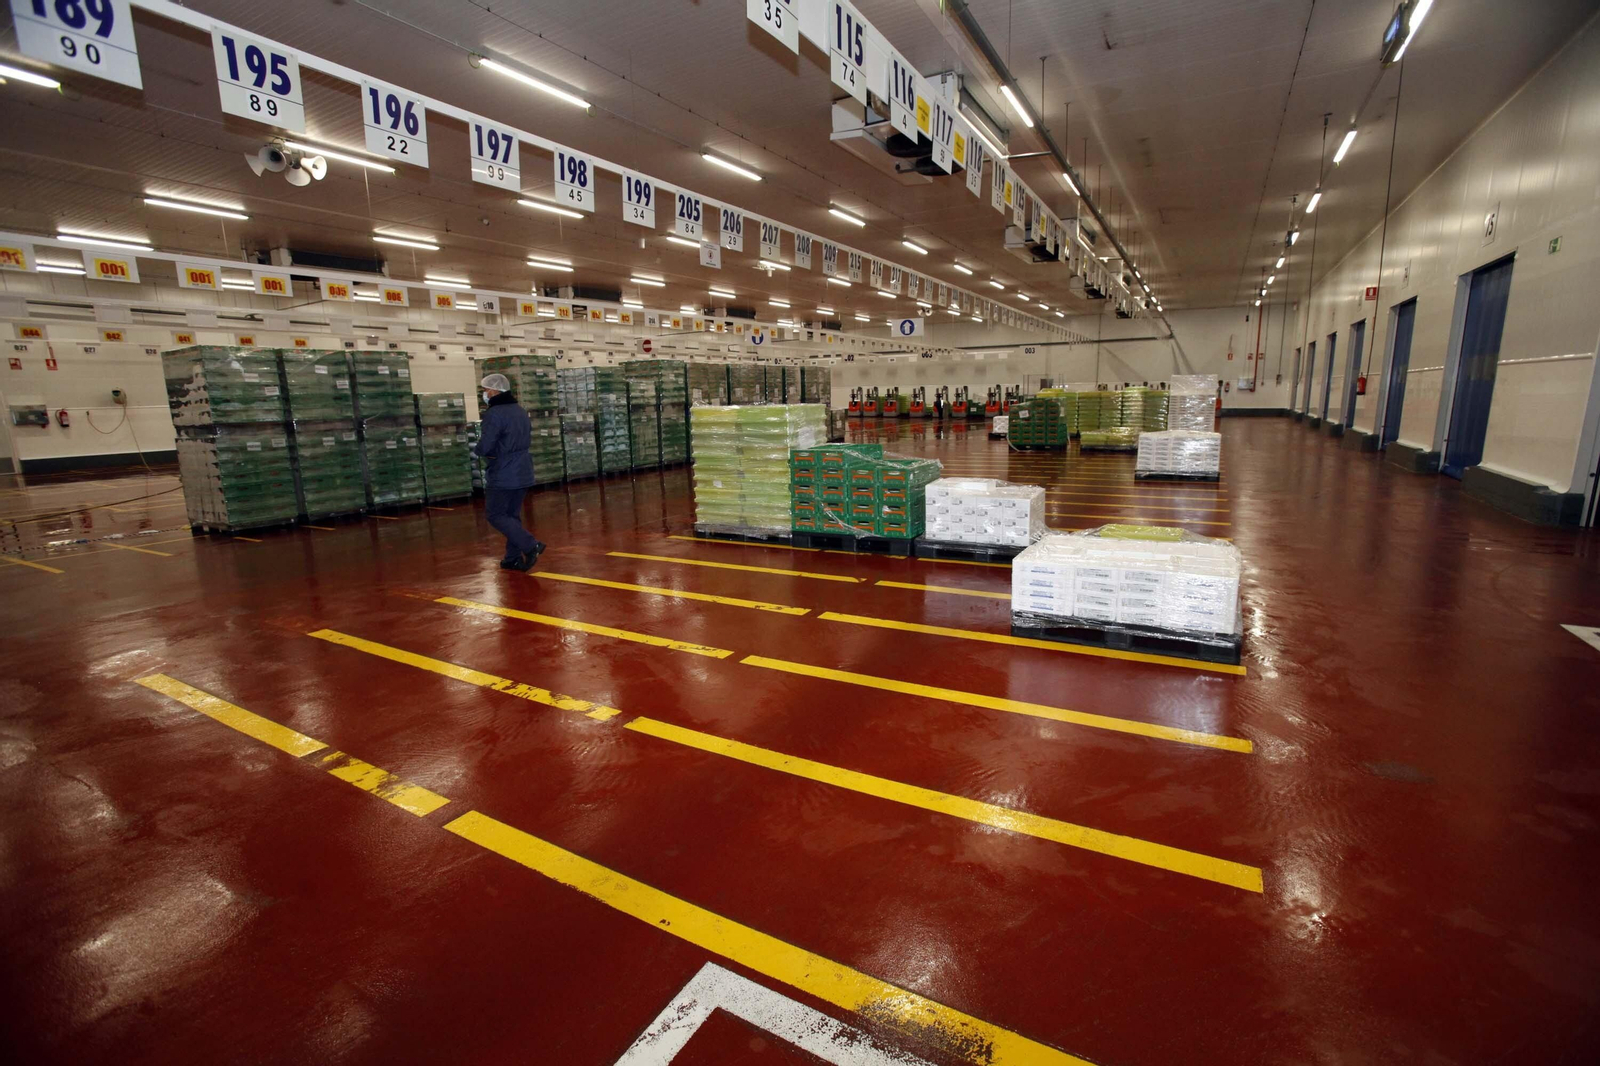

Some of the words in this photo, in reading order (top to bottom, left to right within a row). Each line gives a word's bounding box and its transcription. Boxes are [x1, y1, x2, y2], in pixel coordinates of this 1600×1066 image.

[764, 0, 782, 29] 35
[836, 3, 863, 66] 115
[60, 36, 101, 65] 90
[221, 35, 291, 96] 195
[842, 63, 855, 87] 74
[893, 59, 914, 111] 116
[249, 94, 278, 117] 89
[369, 87, 419, 136] 196
[902, 114, 907, 130] 4
[936, 103, 953, 146] 117
[387, 136, 409, 155] 22
[474, 124, 514, 164] 197
[970, 136, 982, 174] 118
[488, 165, 505, 181] 99
[558, 153, 588, 187] 198
[568, 189, 583, 202] 45
[626, 176, 652, 207] 199
[633, 208, 645, 220] 34
[678, 194, 701, 222] 205
[685, 223, 695, 235] 84
[722, 209, 742, 234] 206
[728, 236, 737, 246] 29
[762, 222, 779, 245] 207
[796, 234, 811, 255] 208
[824, 243, 836, 263] 209
[850, 252, 861, 270] 215
[100, 262, 126, 276] 001
[190, 272, 212, 284] 001
[264, 279, 282, 291] 001
